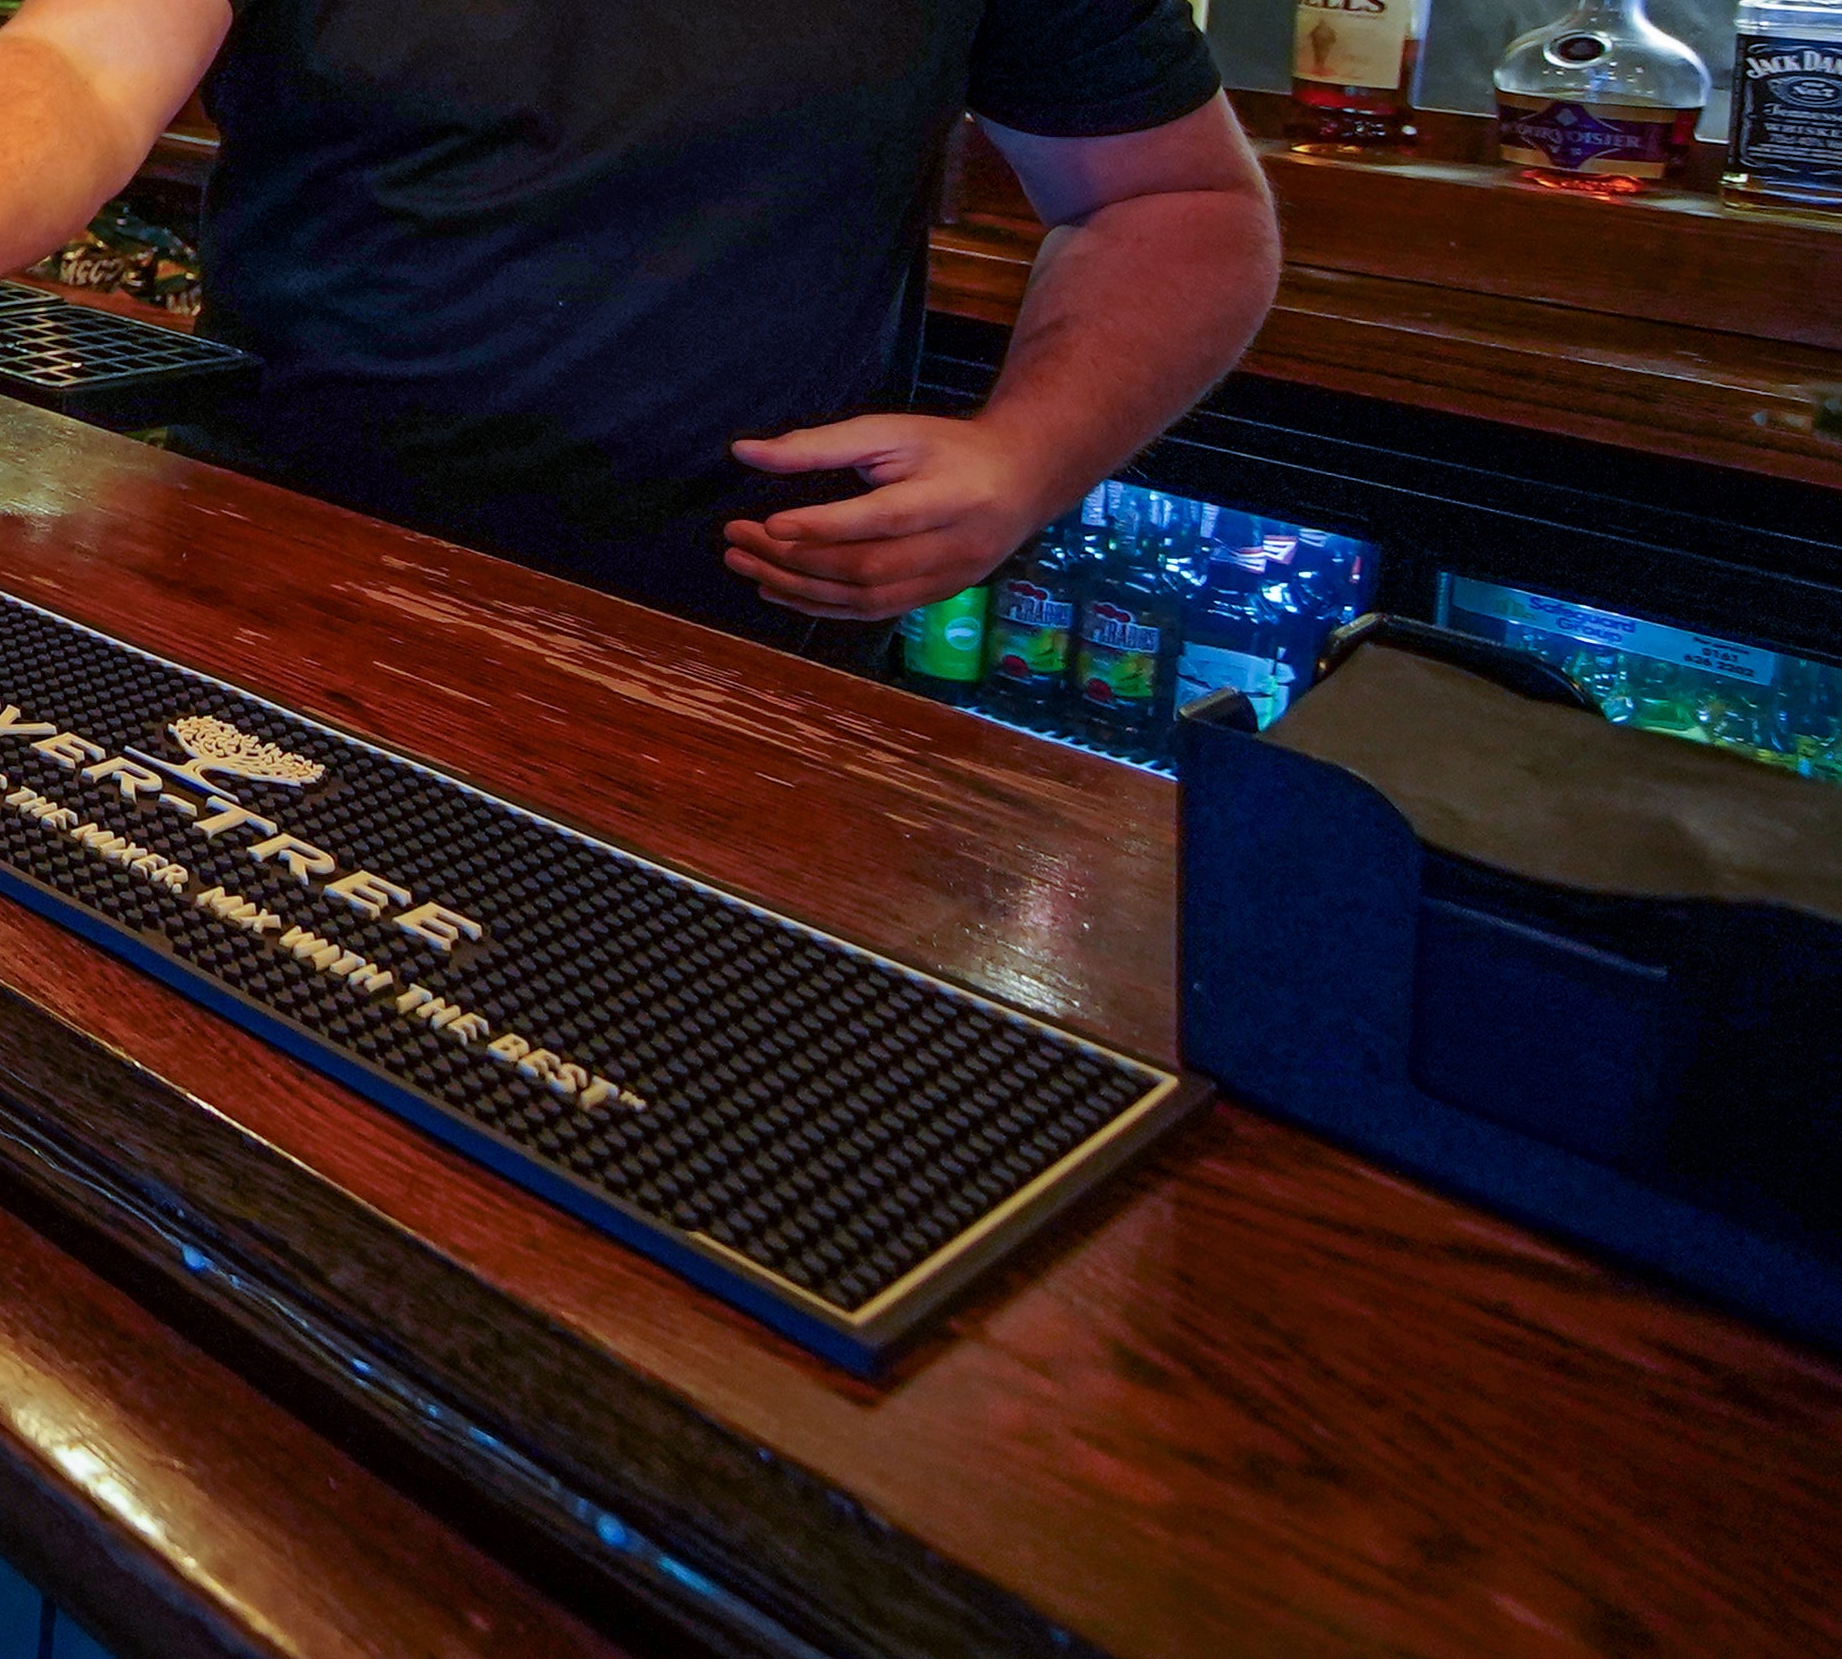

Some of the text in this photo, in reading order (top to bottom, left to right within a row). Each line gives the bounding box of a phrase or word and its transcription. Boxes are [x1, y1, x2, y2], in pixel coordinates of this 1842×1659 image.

[1745, 54, 1802, 80] JACK
[1556, 617, 1624, 644] Group
[4, 785, 79, 831] THE
[196, 885, 282, 934] MIX
[278, 924, 395, 994] WITH
[395, 983, 491, 1047] THE
